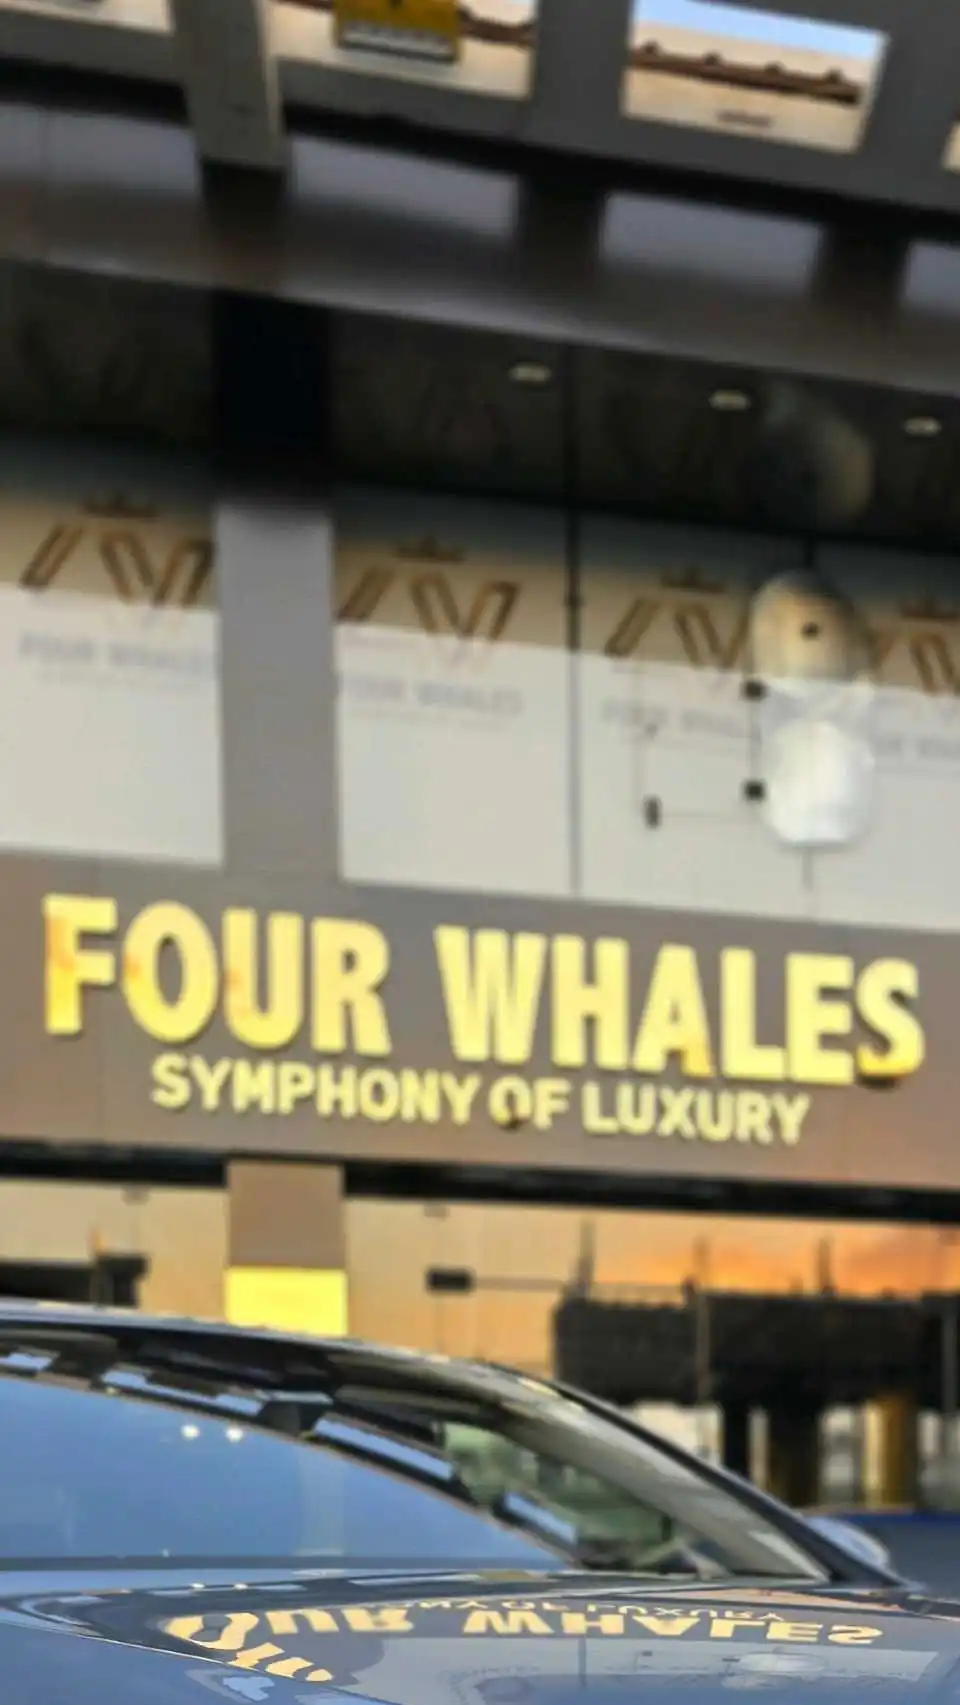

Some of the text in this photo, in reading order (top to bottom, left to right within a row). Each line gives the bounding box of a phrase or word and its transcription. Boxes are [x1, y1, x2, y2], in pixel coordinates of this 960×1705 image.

[42, 892, 926, 1086] FOUR WHALES
[151, 1053, 811, 1145] SYMPHONY OF LUXURY
